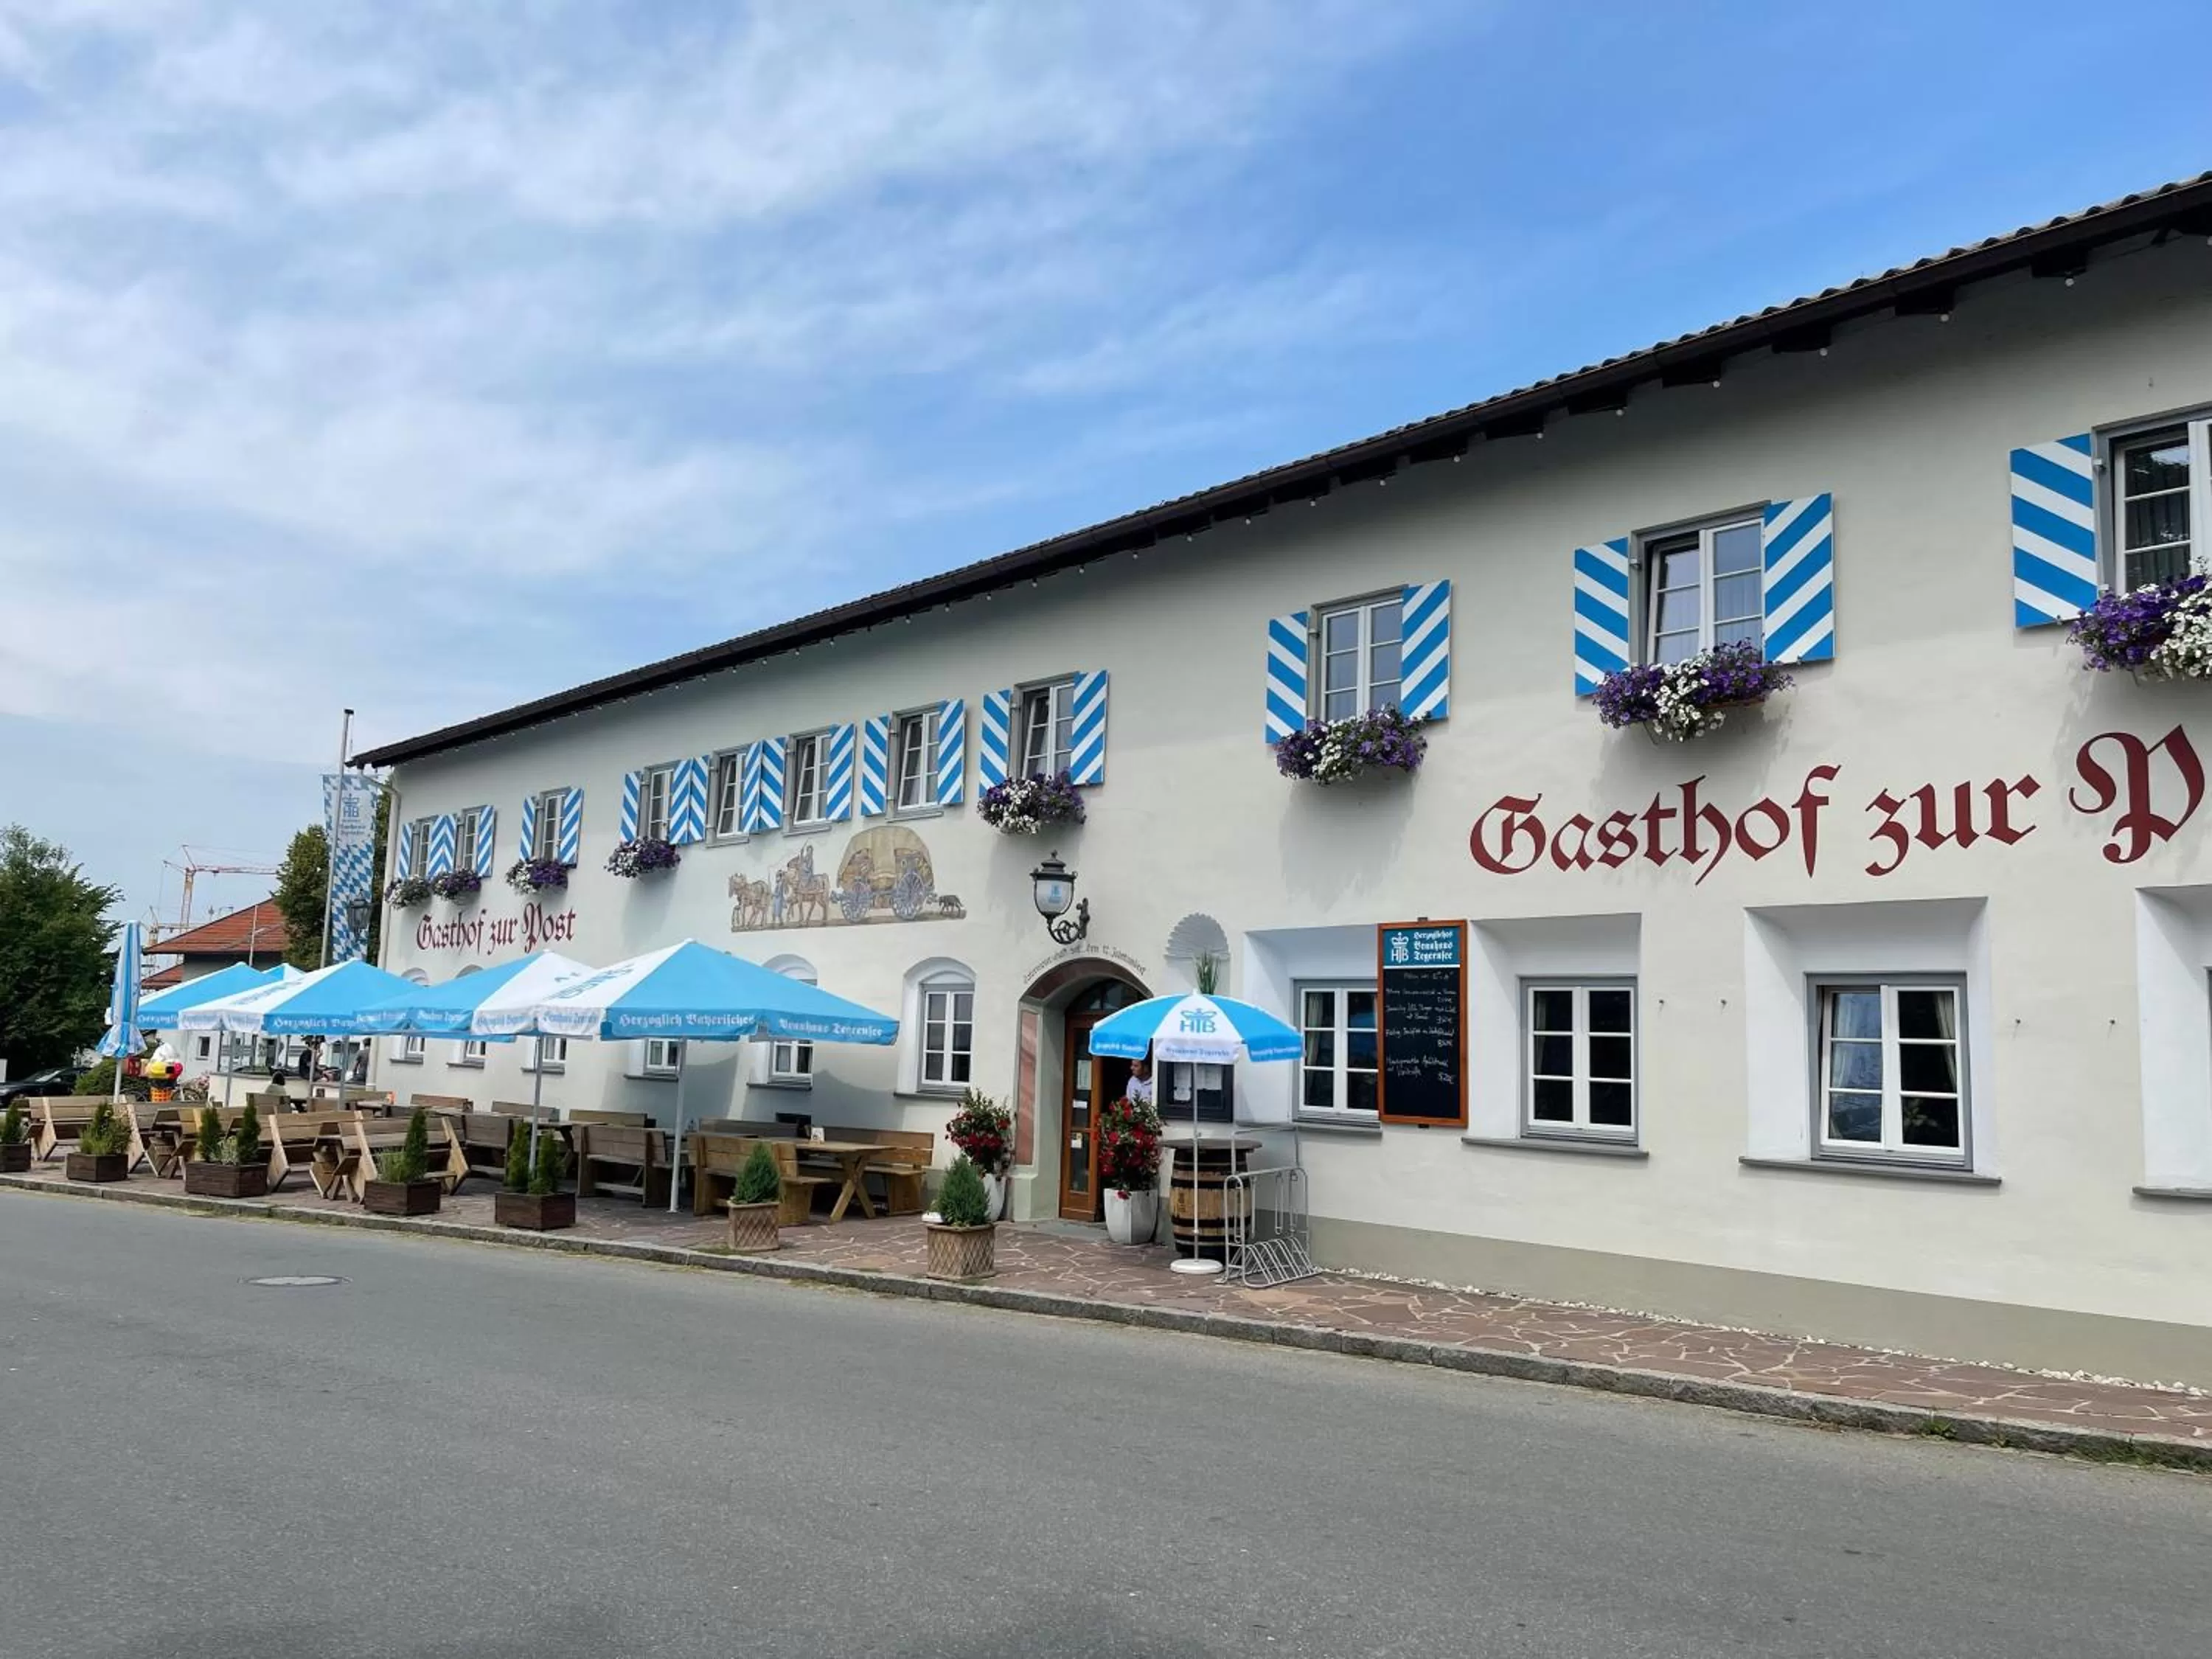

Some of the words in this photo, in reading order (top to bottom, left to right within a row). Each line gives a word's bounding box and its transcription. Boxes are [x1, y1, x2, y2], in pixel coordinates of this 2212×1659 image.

[1470, 764, 1842, 886] Gasthof
[1865, 773, 2041, 877] zur
[417, 908, 487, 956] Gasthof
[487, 917, 518, 956] zur
[521, 901, 577, 953] Post
[1413, 950, 1453, 962] Tegernsee
[619, 1014, 682, 1028] Herzoglich
